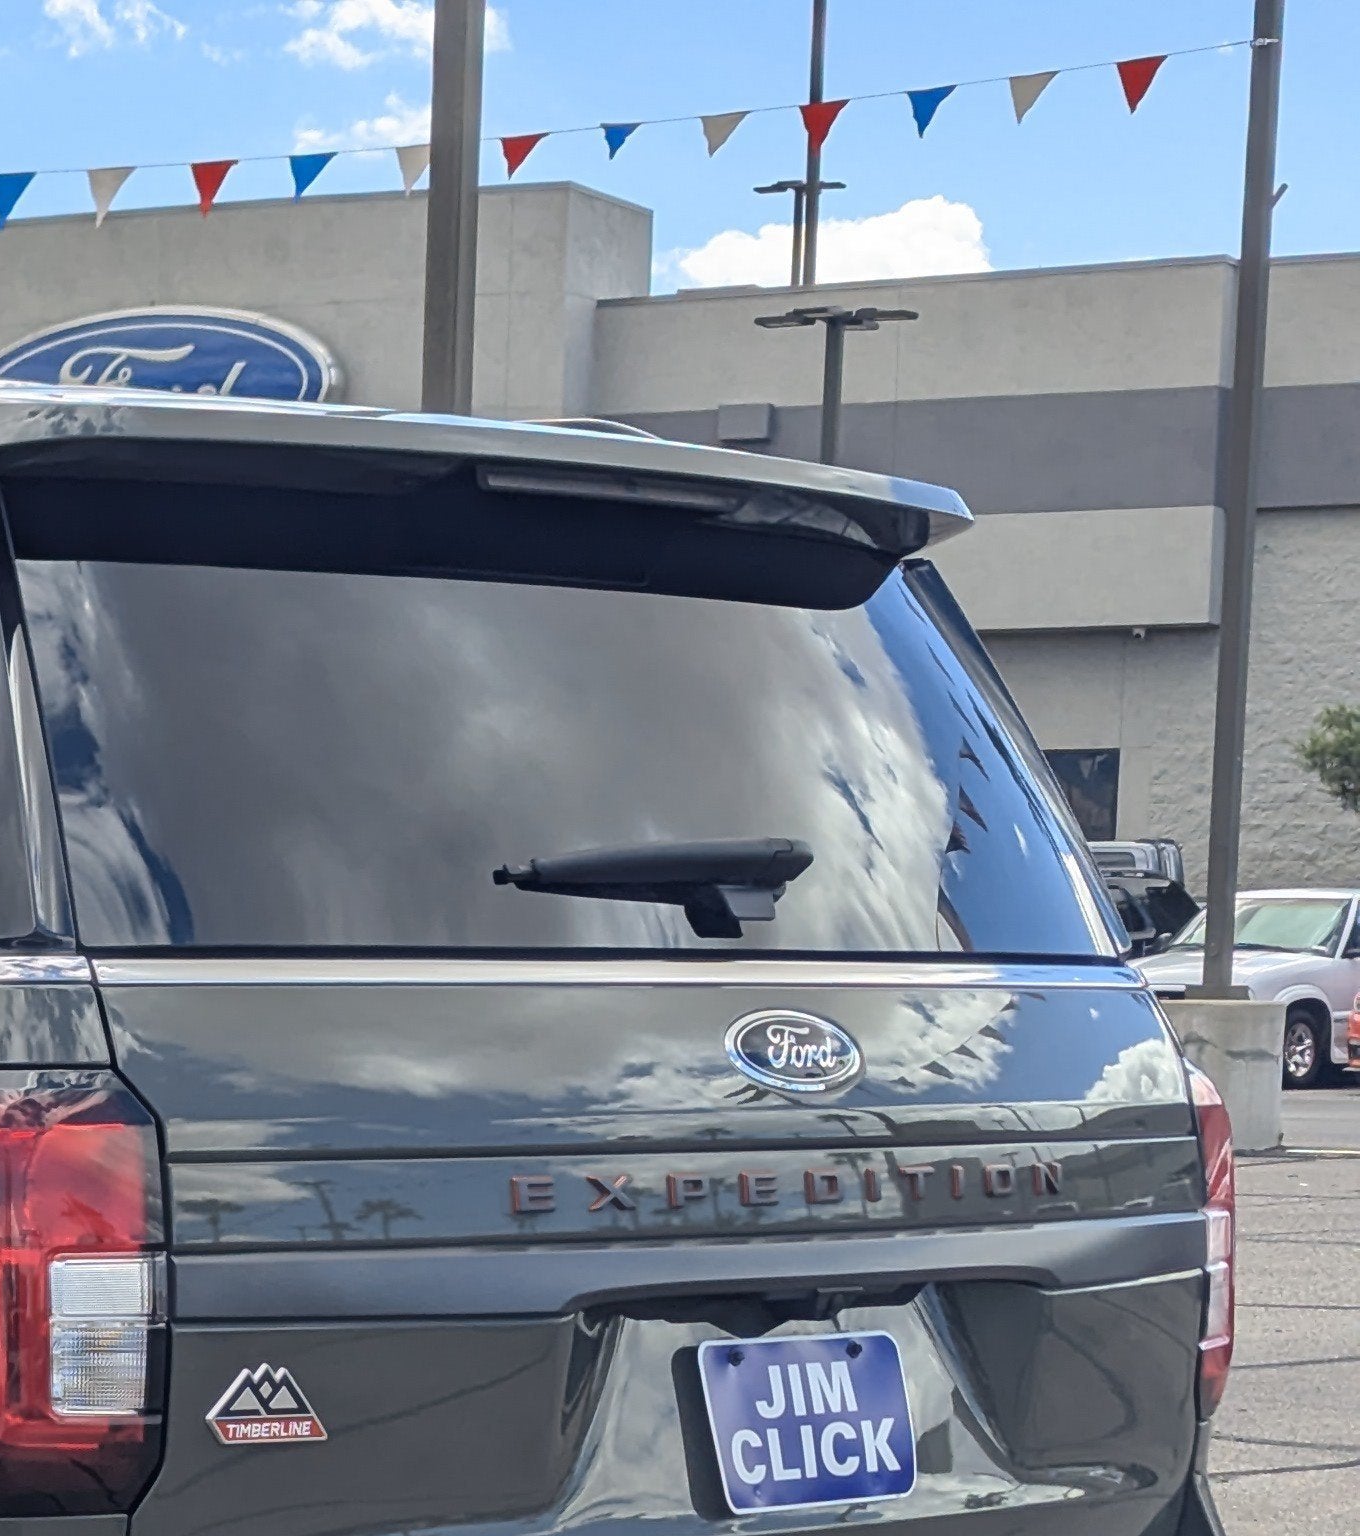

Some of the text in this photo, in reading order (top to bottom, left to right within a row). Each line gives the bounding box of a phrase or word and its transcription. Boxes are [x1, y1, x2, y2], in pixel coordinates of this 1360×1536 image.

[766, 1024, 837, 1068] Ford
[510, 1162, 1062, 1213] EXPEDITION
[755, 1361, 859, 1419] JIM
[226, 1420, 312, 1438] TIMBERLINE
[731, 1417, 902, 1485] CLICK
